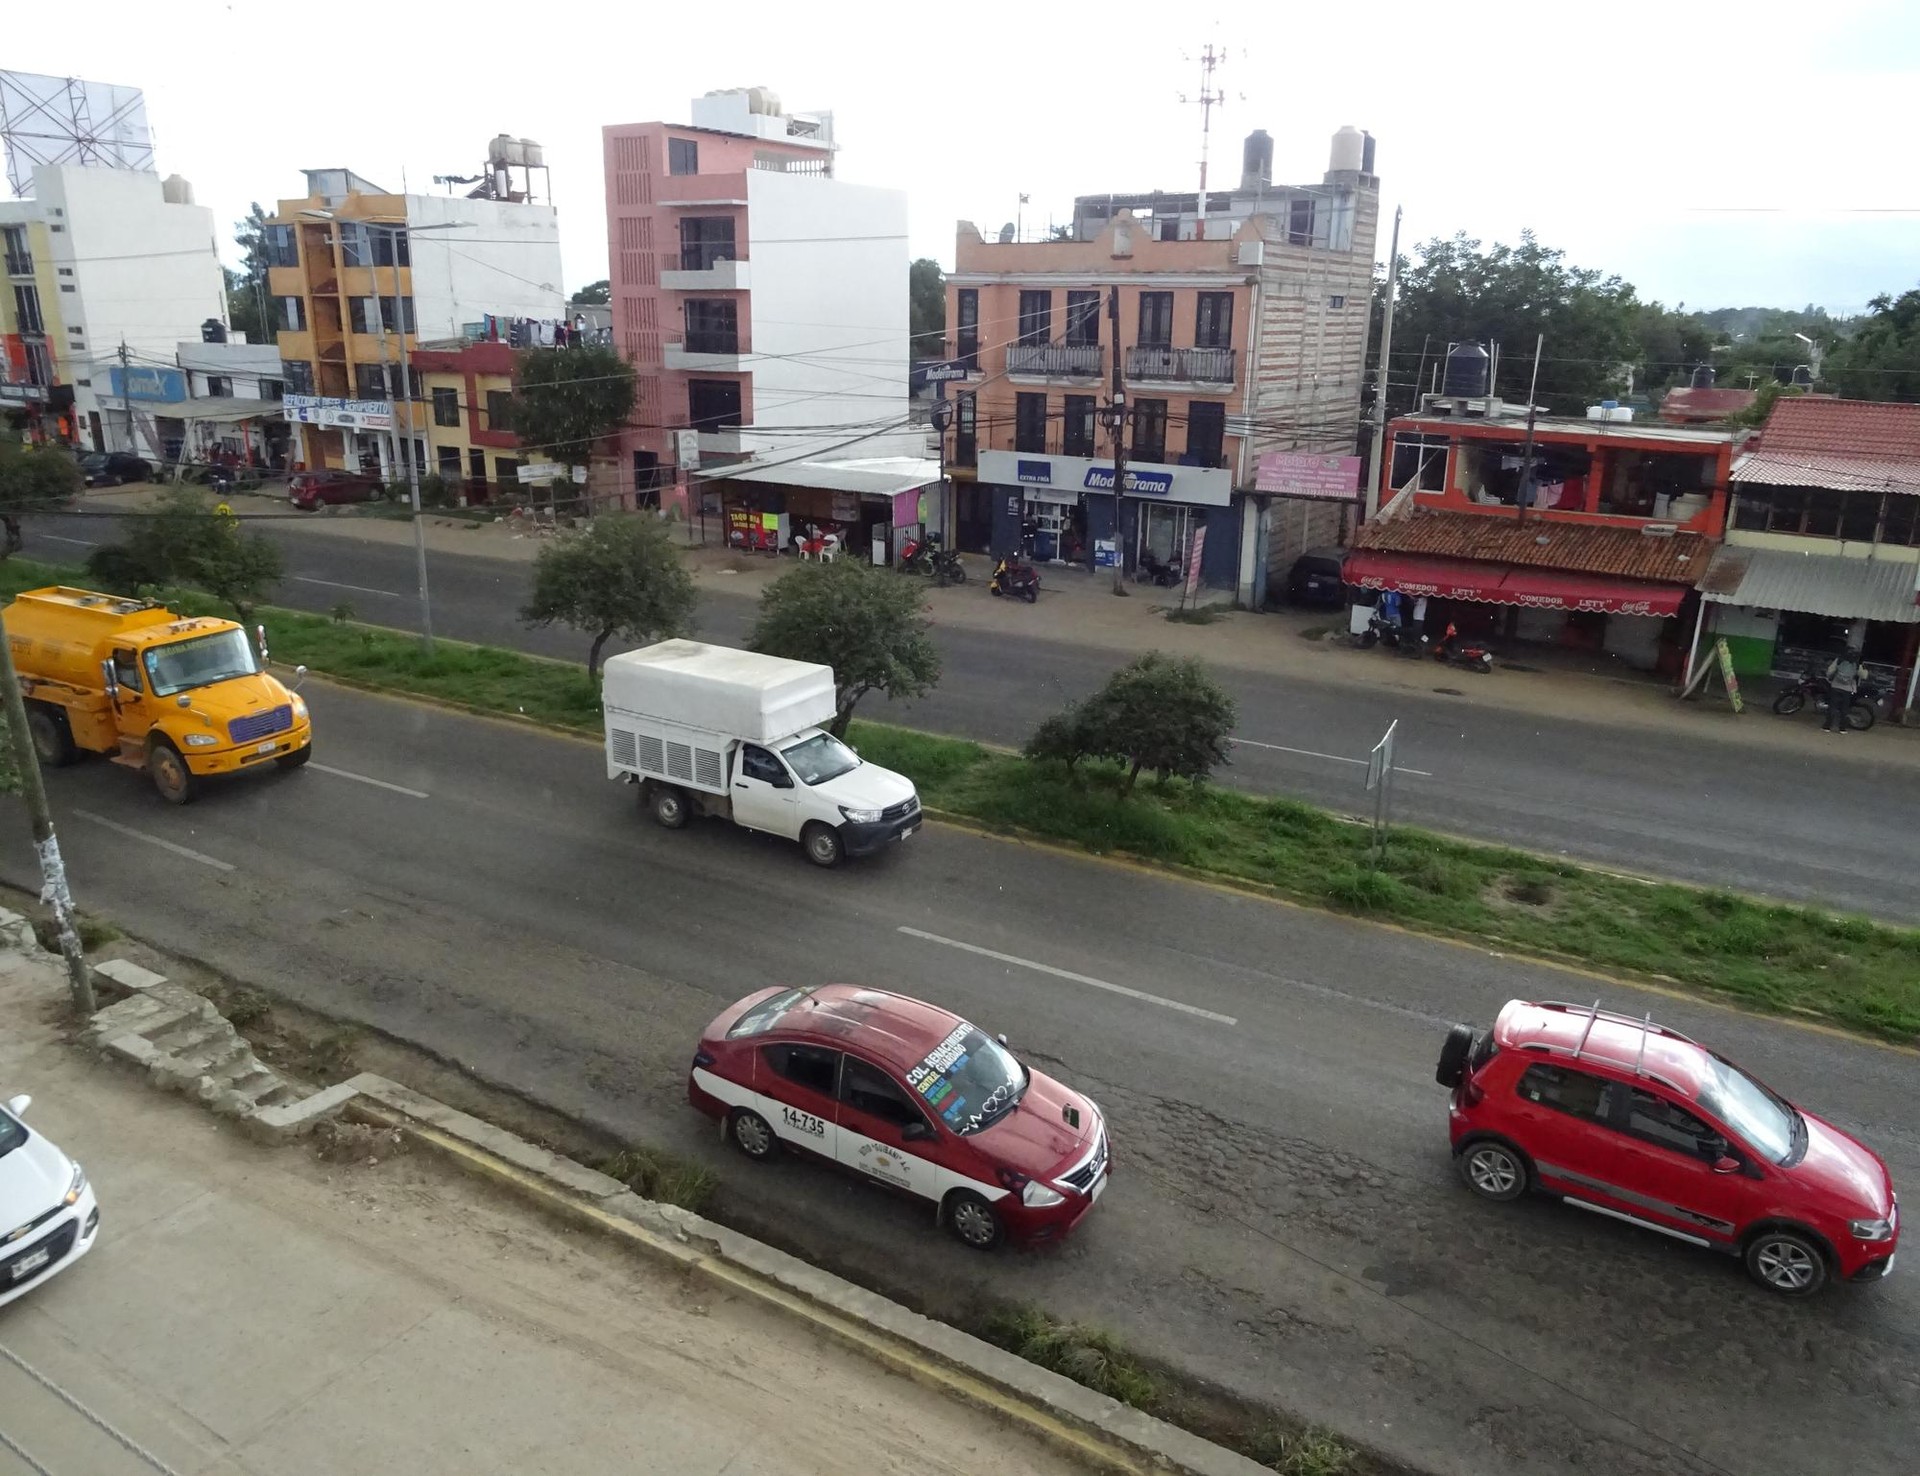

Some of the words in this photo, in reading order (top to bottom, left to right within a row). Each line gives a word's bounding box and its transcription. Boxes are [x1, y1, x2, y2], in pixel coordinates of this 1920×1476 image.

[1020, 474, 1037, 482] EXTRA
[1088, 472, 1167, 493] Modorama
[905, 1065, 931, 1085] COL.
[923, 1022, 974, 1068] RENACIMIENTO
[935, 1044, 968, 1074] GUARDADO
[782, 1106, 825, 1135] 14-735
